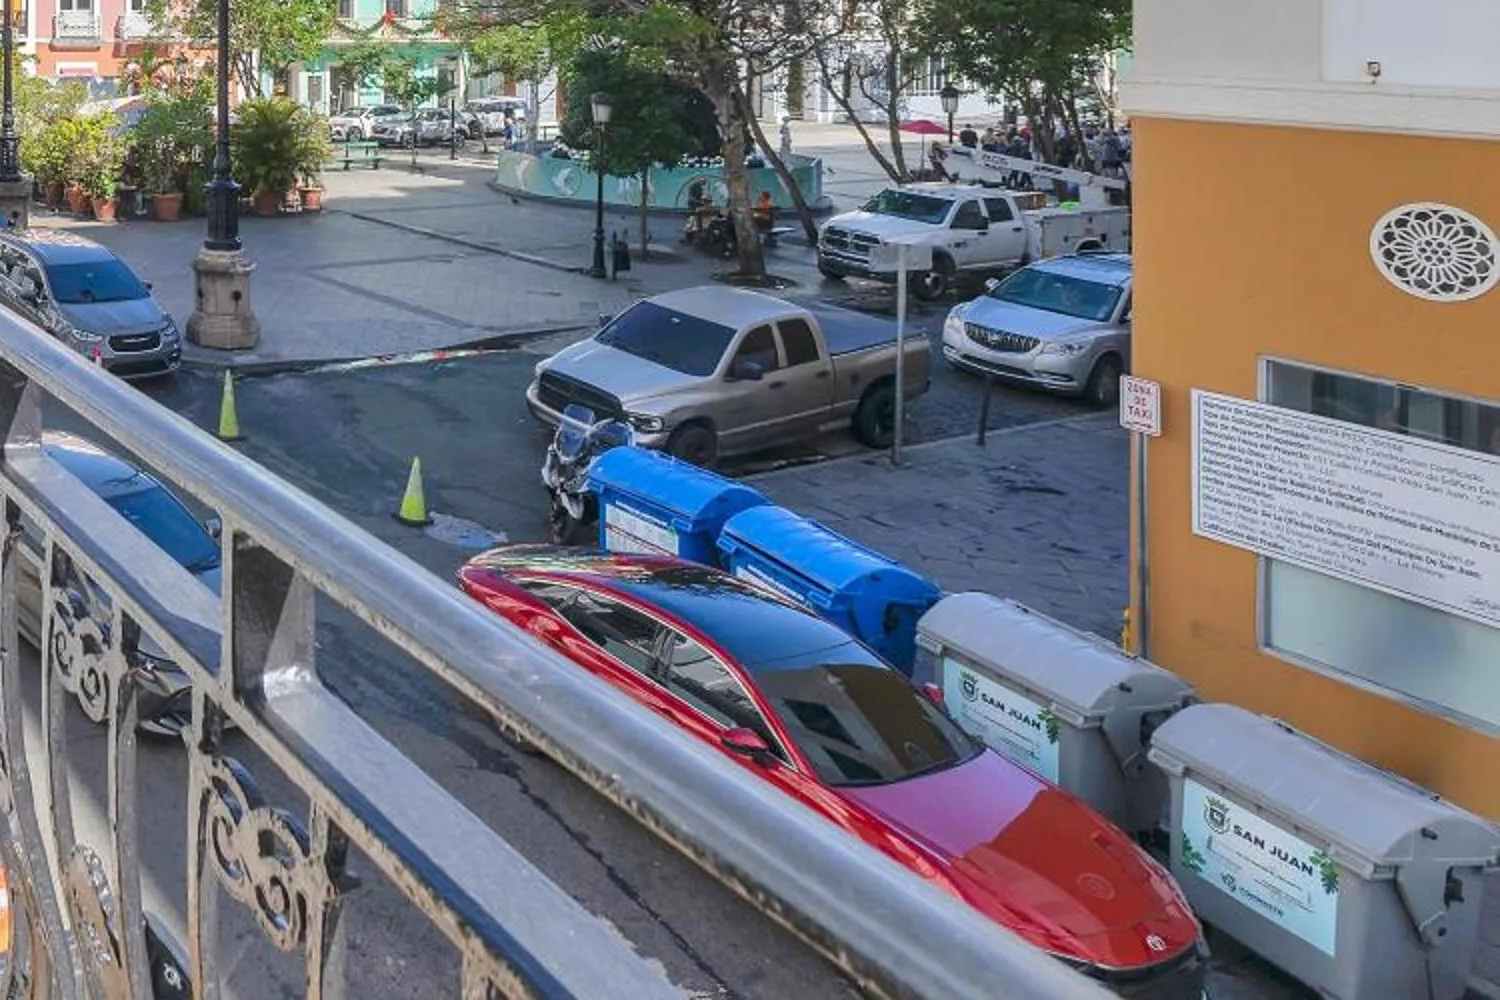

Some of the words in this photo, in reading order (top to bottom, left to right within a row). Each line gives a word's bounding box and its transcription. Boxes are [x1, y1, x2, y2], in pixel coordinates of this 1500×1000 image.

[1127, 382, 1152, 395] ZONA
[1134, 395, 1147, 406] DE
[1128, 406, 1153, 420] TAXI
[981, 692, 1005, 712] SAN
[1008, 708, 1041, 730] JUAN
[1233, 824, 1265, 850] SAN
[1269, 845, 1314, 877] JUAN
